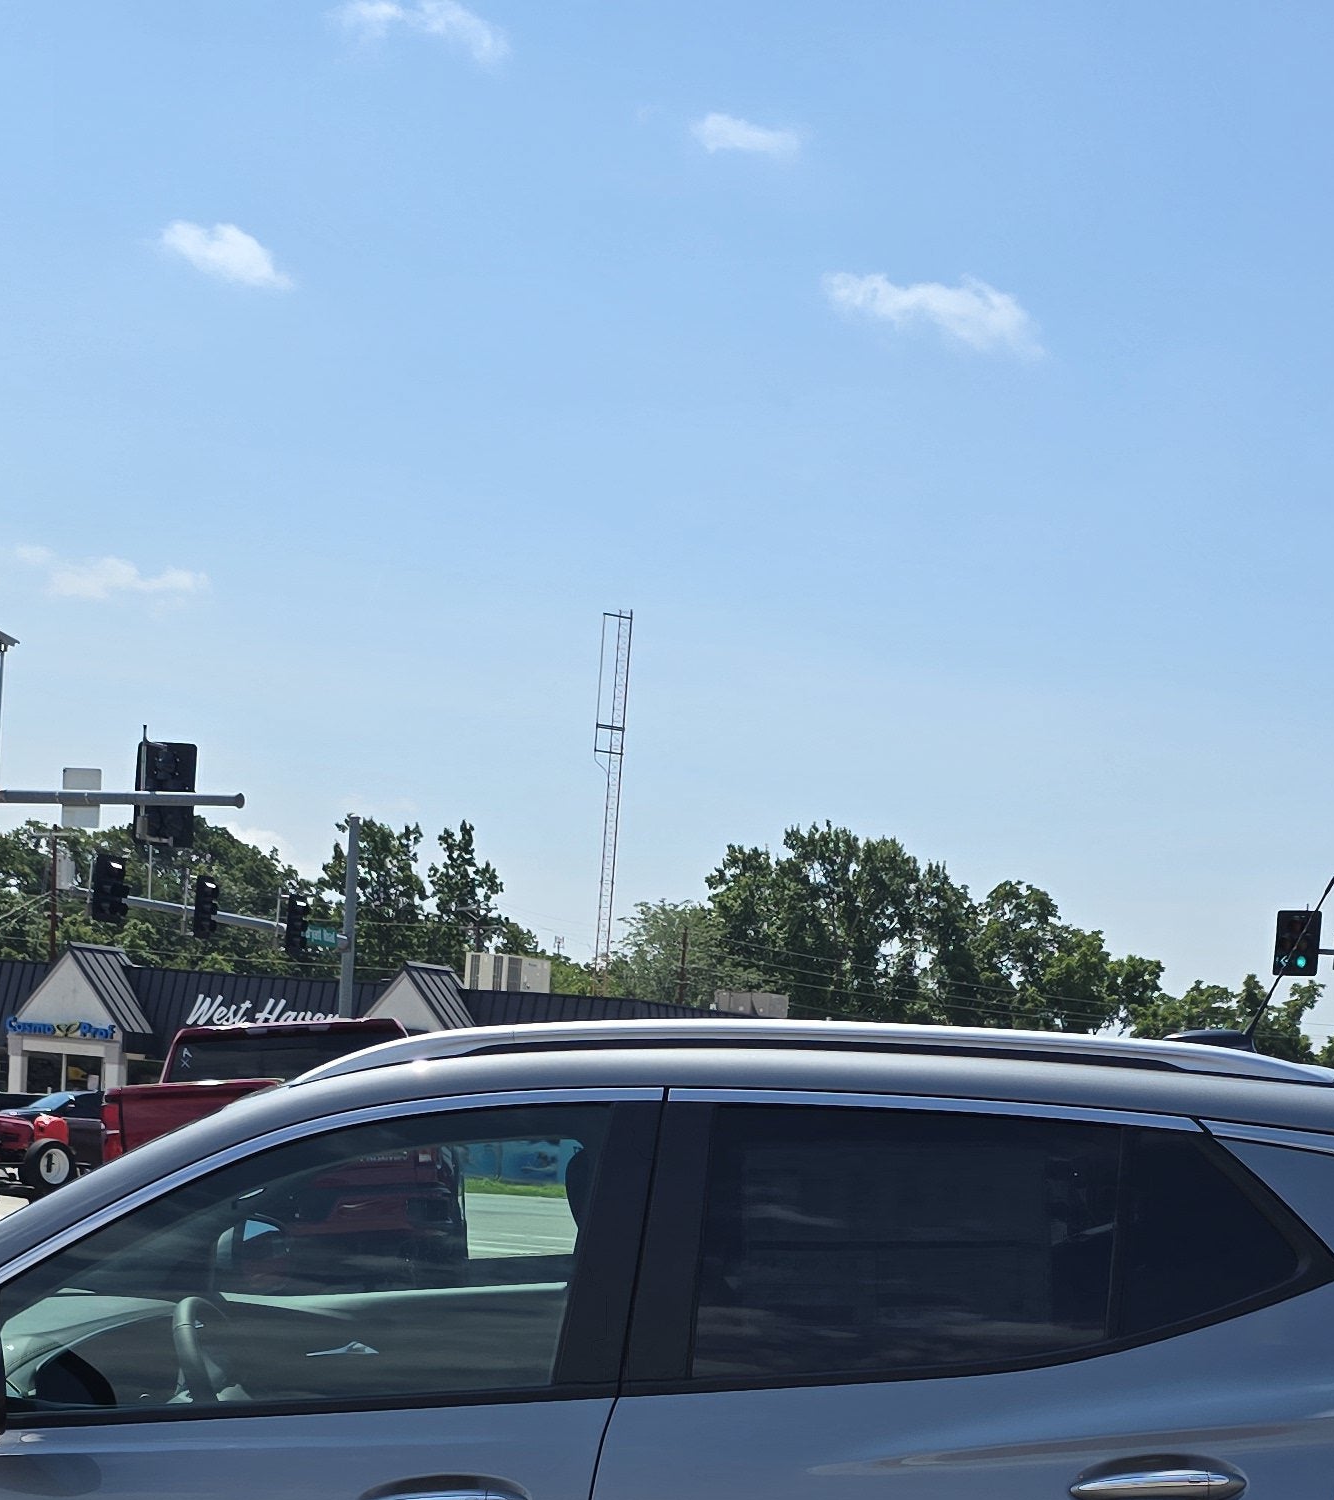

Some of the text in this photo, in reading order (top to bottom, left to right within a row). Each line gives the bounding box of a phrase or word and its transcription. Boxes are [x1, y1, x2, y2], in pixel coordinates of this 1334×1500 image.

[186, 993, 253, 1026] West
[6, 1016, 117, 1040] Cosmo Prof
